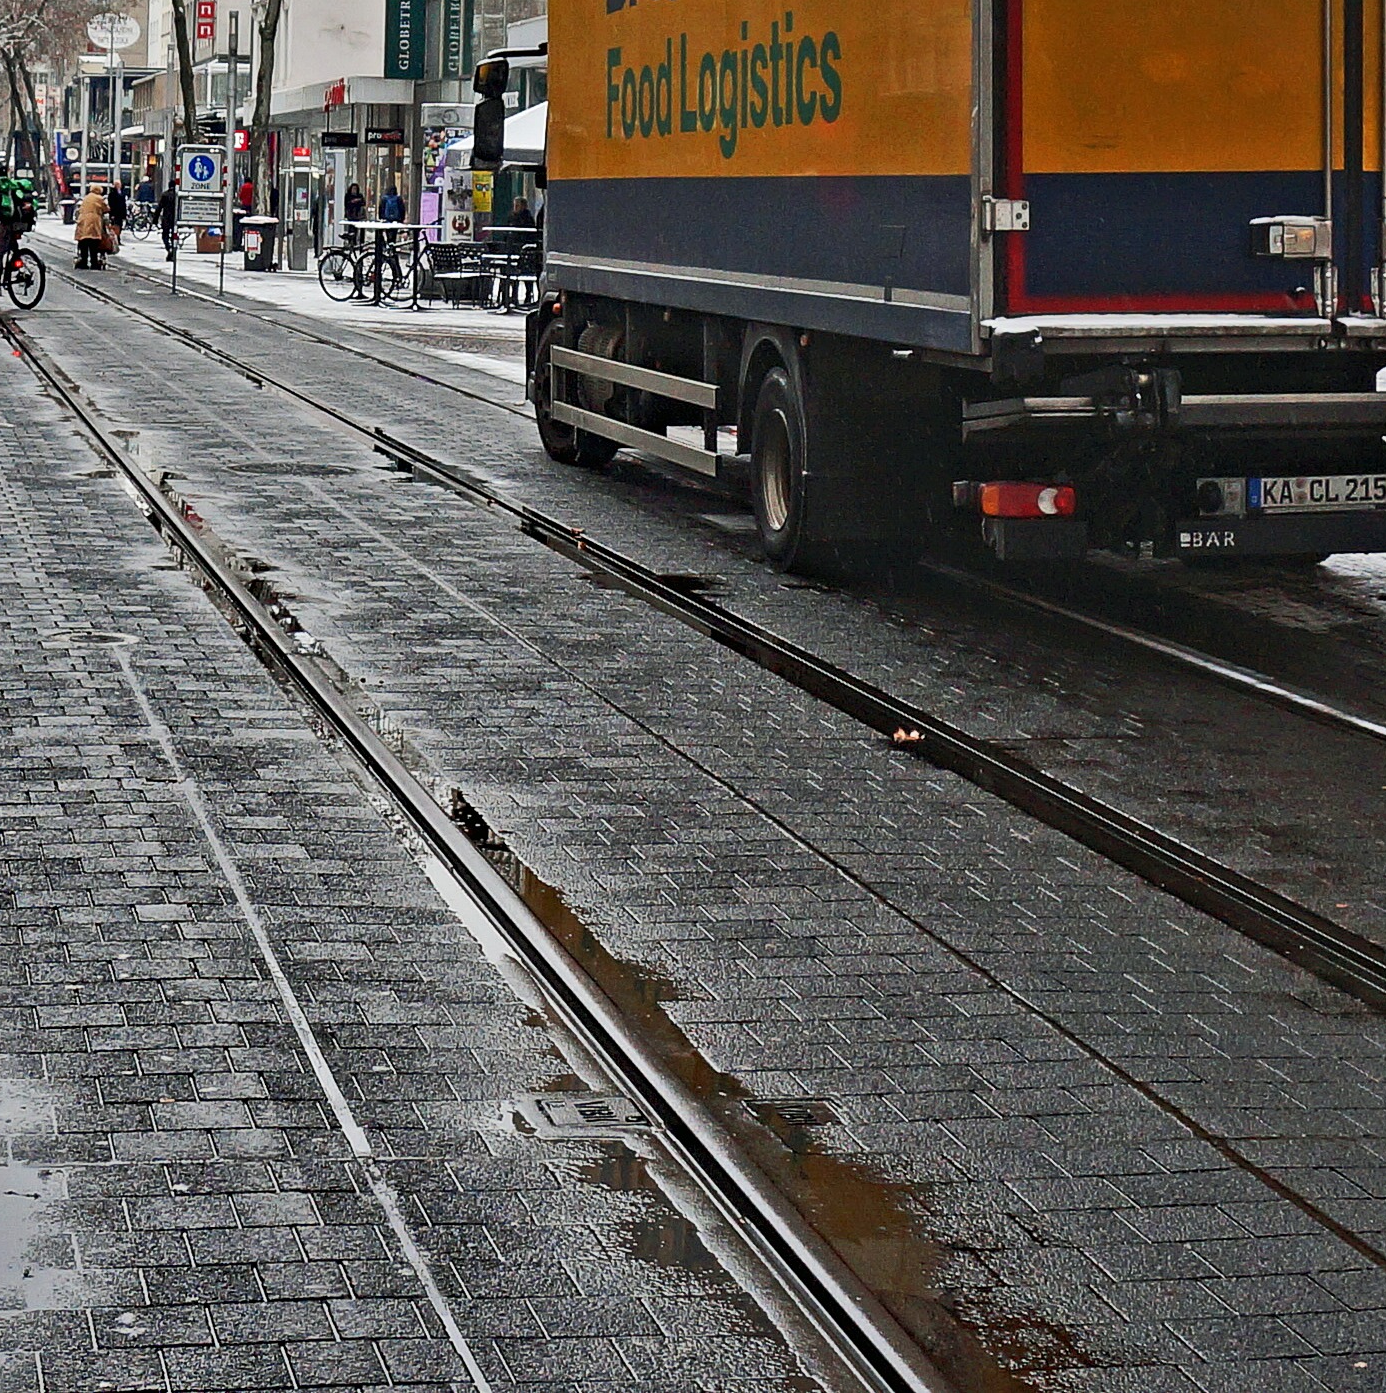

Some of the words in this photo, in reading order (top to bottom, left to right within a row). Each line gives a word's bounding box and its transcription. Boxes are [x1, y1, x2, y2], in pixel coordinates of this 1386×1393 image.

[605, 37, 673, 140] Food
[679, 10, 843, 160] Logistics
[191, 182, 211, 190] ZONE
[1264, 480, 1293, 504] KA
[1309, 479, 1339, 503] CL
